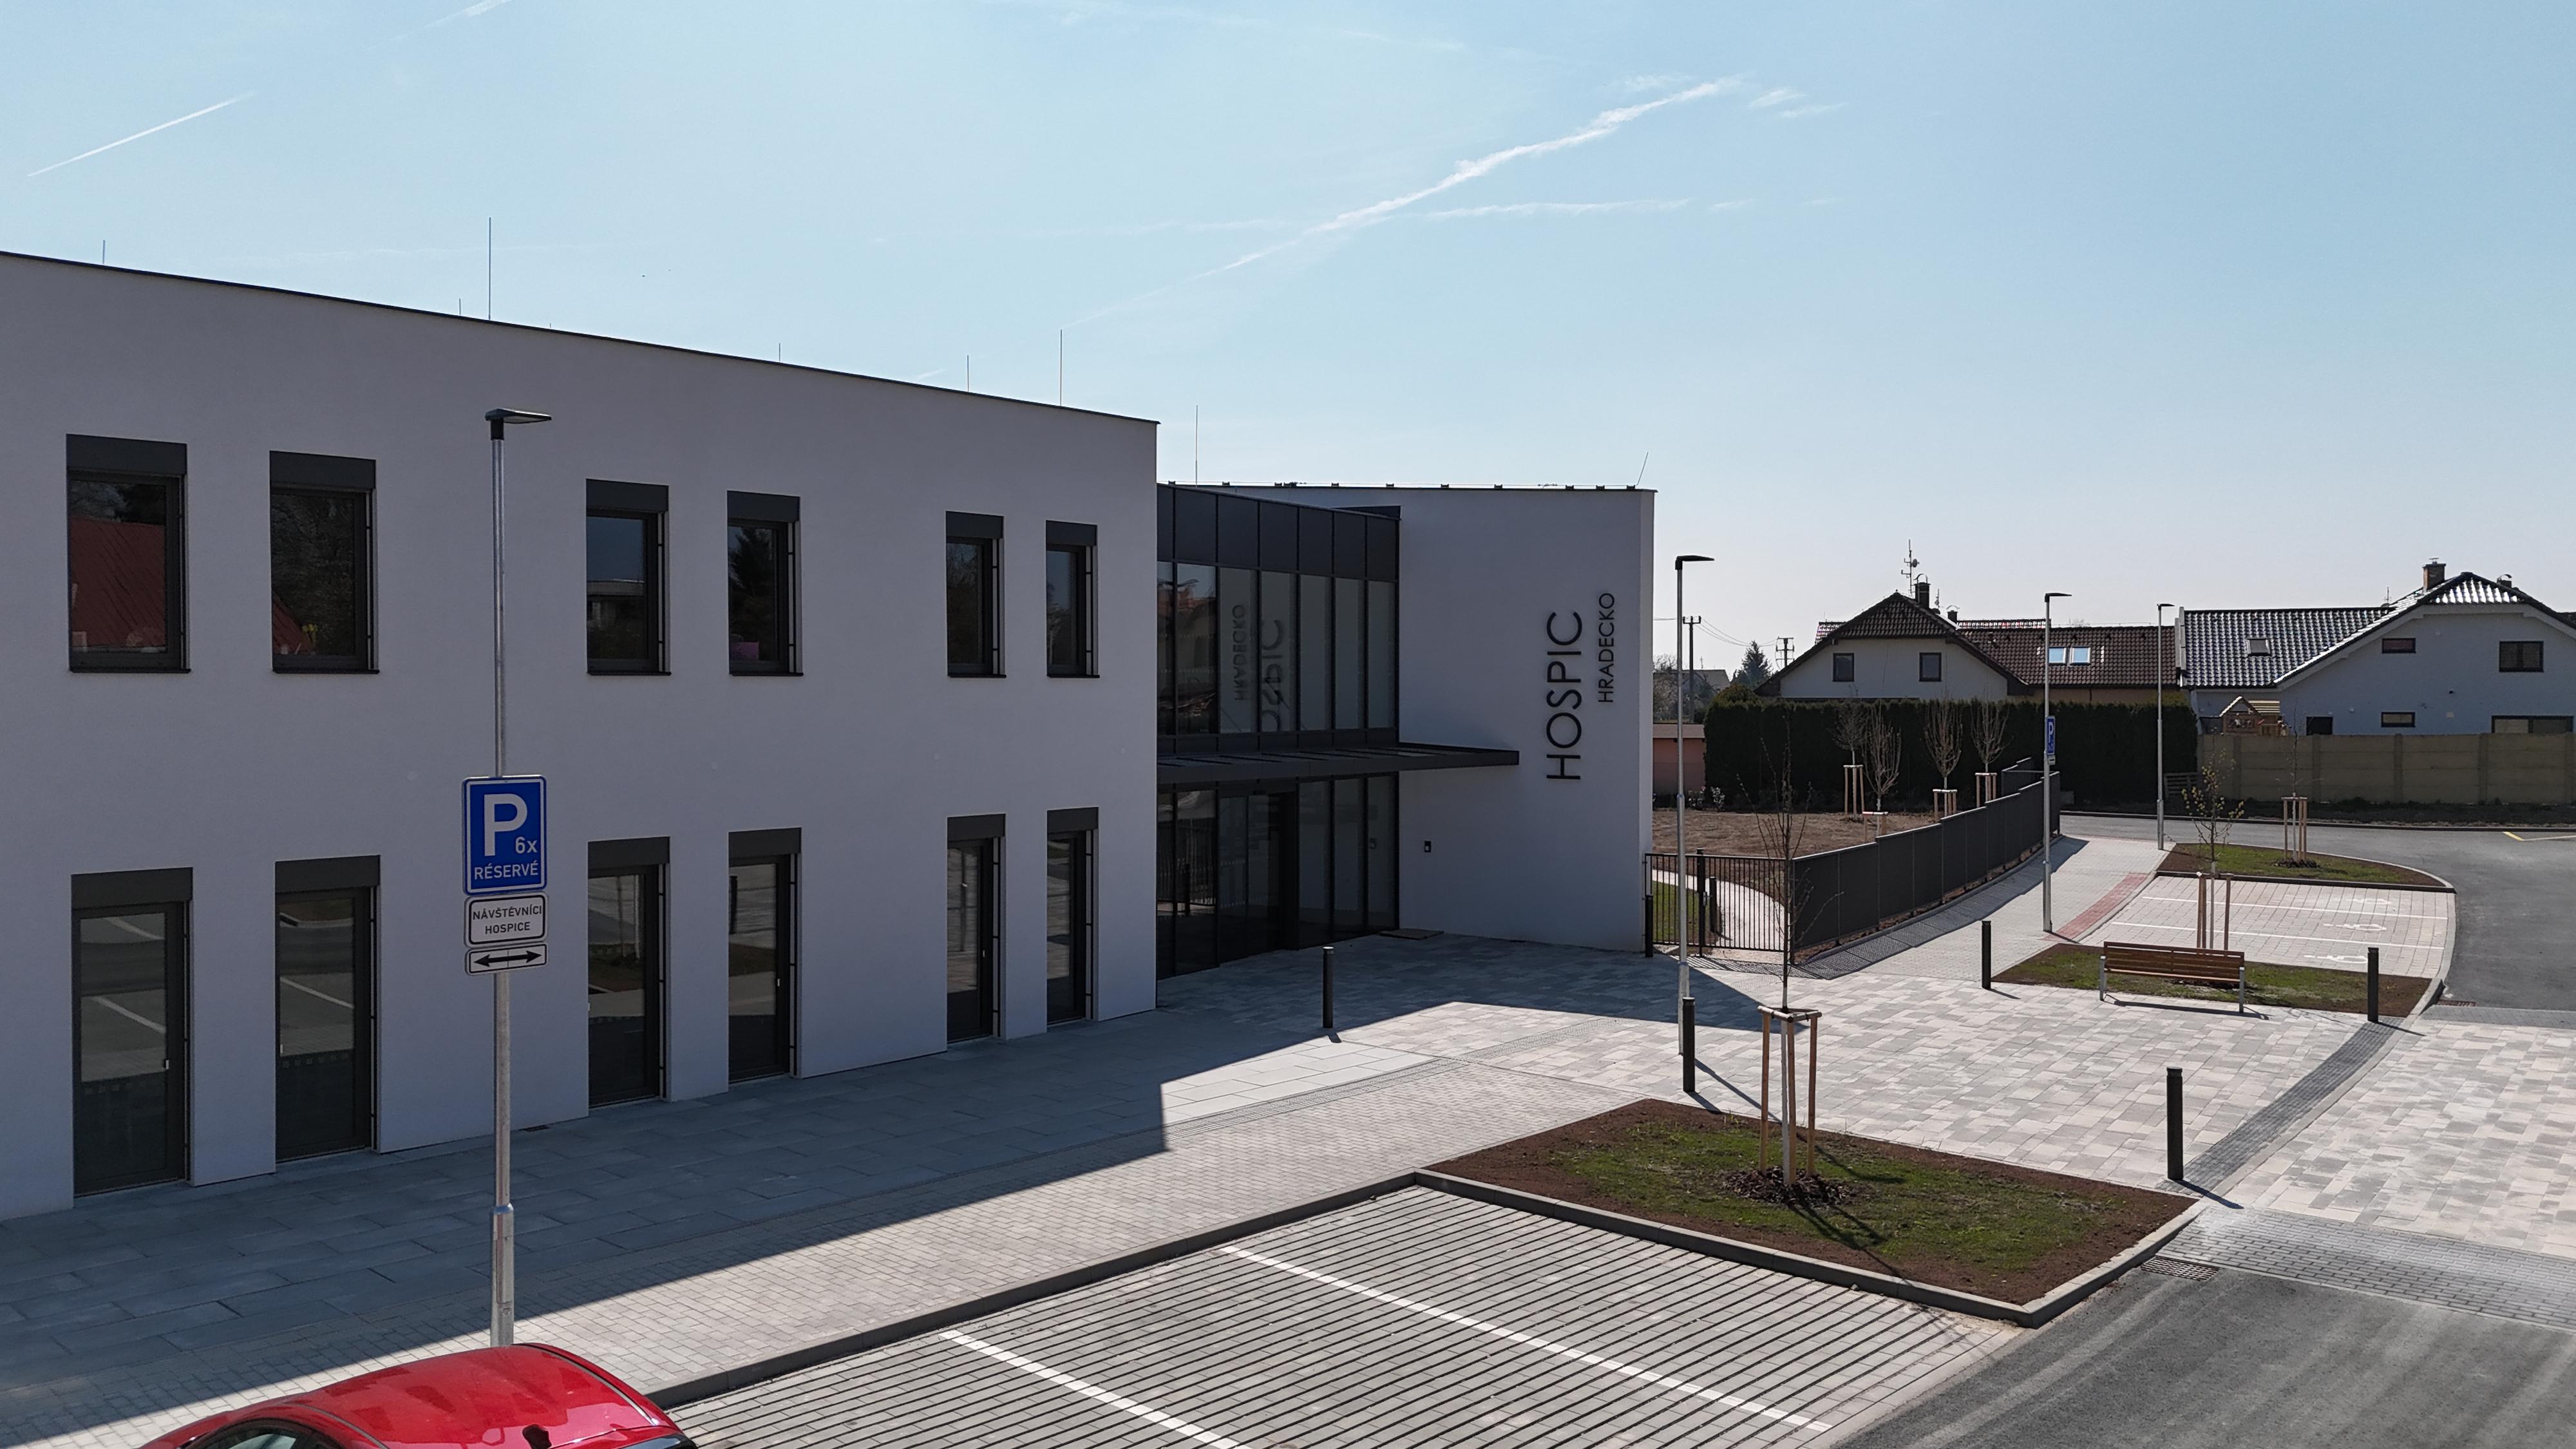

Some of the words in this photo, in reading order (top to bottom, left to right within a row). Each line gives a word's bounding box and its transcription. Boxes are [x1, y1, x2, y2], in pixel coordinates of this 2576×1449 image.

[1598, 592, 1615, 703] HRADECKO
[1546, 611, 1582, 780] HOSPIC
[2049, 721, 2054, 743] P
[484, 793, 528, 857] P
[515, 836, 538, 854] 6x
[474, 860, 538, 880] RÉSERVÉ
[472, 904, 542, 921] NÁVŠTĚVNÍCI
[484, 922, 531, 935] HOSPICE
